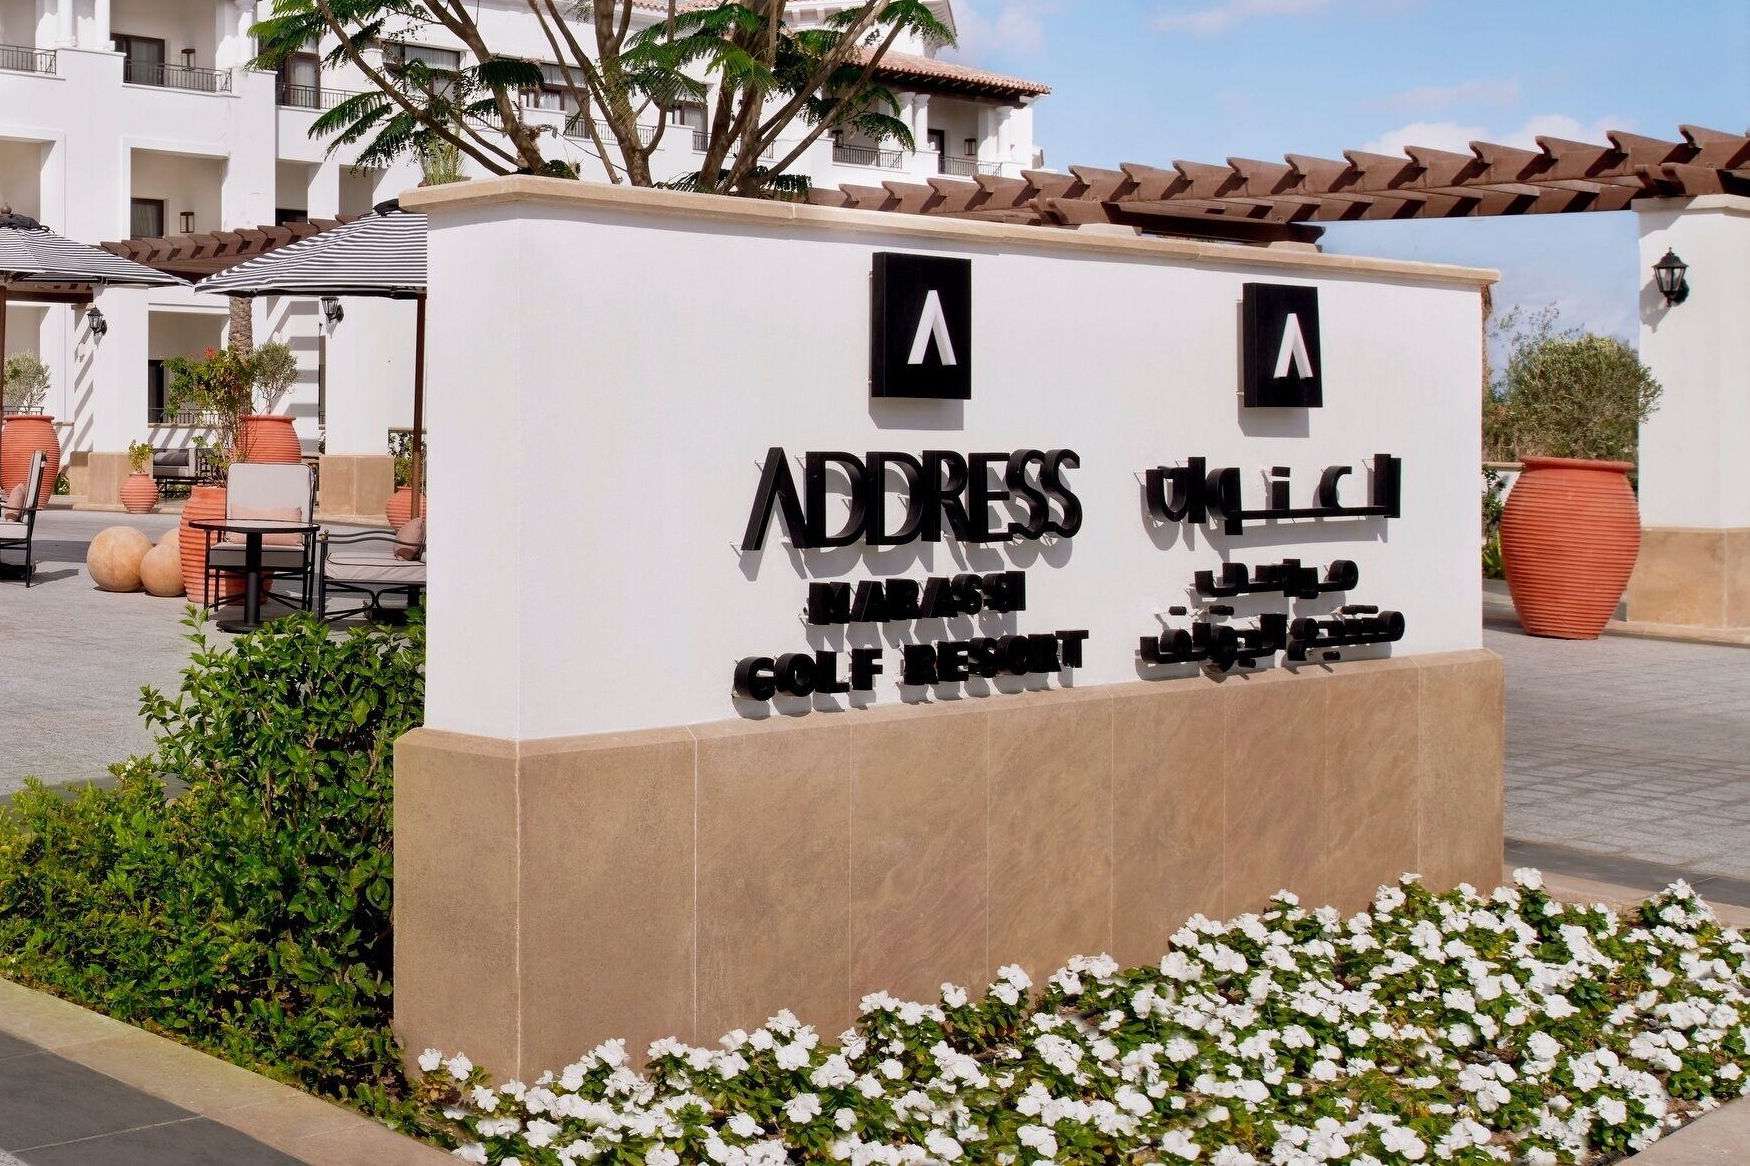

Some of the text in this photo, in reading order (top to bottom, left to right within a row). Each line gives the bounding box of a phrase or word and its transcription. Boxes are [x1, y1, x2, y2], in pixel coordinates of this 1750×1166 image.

[741, 447, 1083, 550] ADDRESS
[808, 571, 1027, 625] MARASSI
[734, 630, 1090, 701] GOLF RESORT
